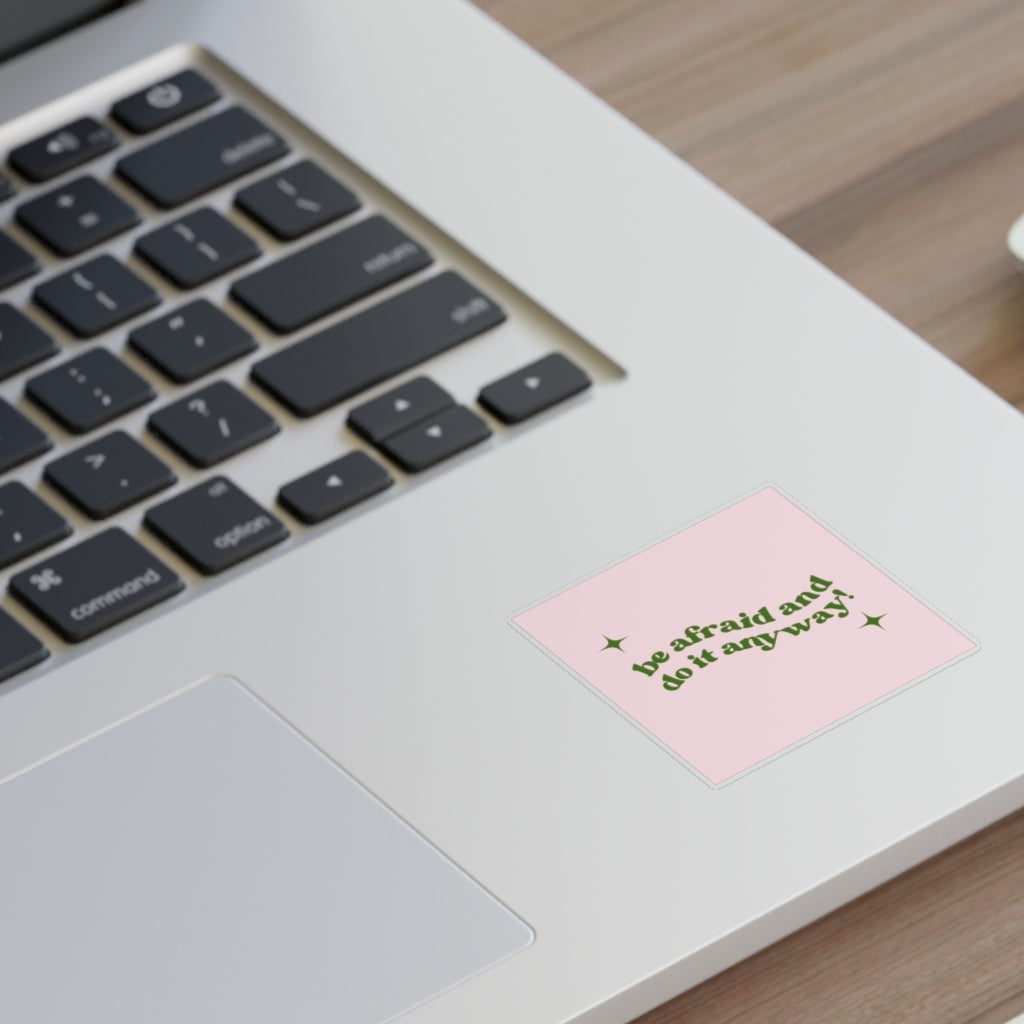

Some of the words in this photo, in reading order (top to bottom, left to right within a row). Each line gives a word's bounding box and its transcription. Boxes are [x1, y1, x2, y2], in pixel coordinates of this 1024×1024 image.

[214, 515, 271, 549] option
[71, 568, 161, 620] command
[632, 651, 670, 677] be
[670, 606, 776, 652] afraid
[778, 574, 833, 616] and
[662, 667, 694, 691] do
[687, 649, 718, 668] it
